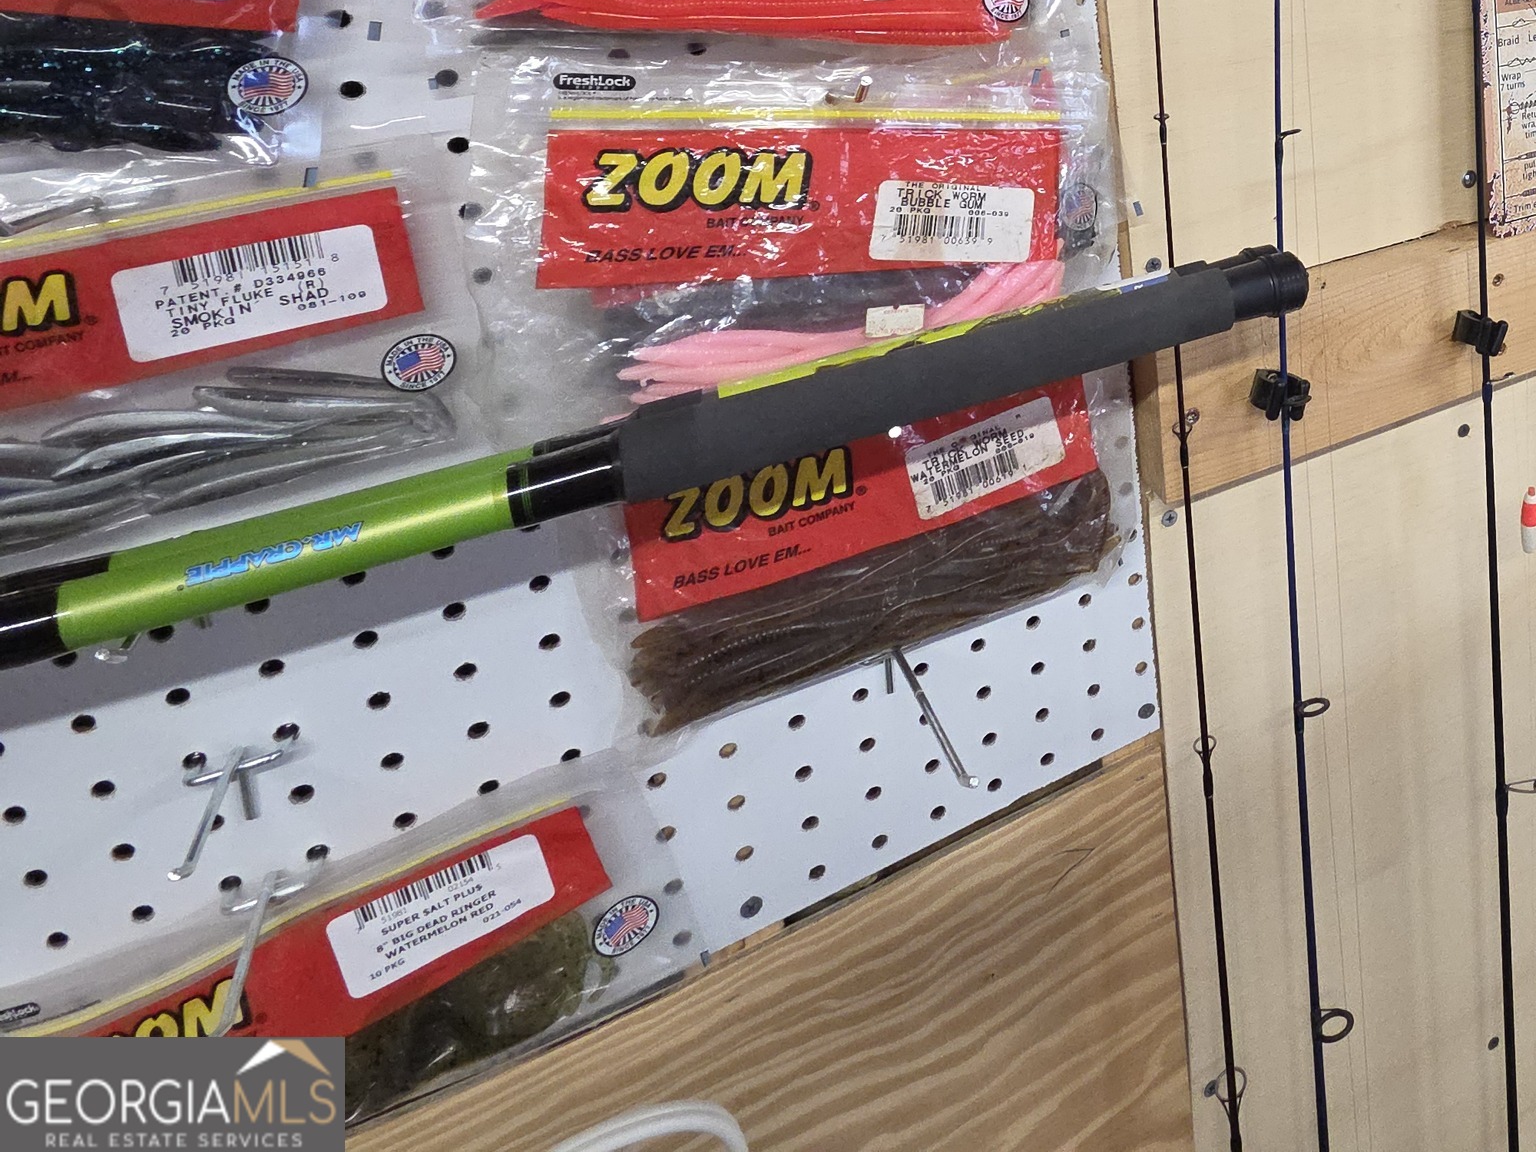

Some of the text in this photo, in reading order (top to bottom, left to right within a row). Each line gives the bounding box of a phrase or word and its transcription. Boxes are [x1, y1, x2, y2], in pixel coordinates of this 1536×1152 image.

[1498, 36, 1520, 47] Braid
[558, 74, 632, 88] FreshLock
[1501, 72, 1522, 82] Wrap
[581, 147, 814, 213] ZOOM
[905, 181, 924, 189] THE
[897, 188, 987, 201] TRICK WORM
[901, 198, 983, 210] BUBBLE GUM
[706, 217, 736, 230] BAIT
[583, 246, 702, 264] BASS LOVE
[253, 267, 326, 288] D334966
[168, 288, 274, 318] TINY FLUKE
[279, 287, 329, 306] SHAD
[203, 290, 367, 331] PKG 081-109
[14, 331, 84, 354] COMPANY
[910, 429, 1024, 483] WATERMELON SEED
[922, 448, 965, 470] TRICK
[662, 445, 853, 542] ZOOM
[768, 501, 855, 537] BAIT COMPANY
[673, 553, 770, 590] BASS LOVE
[380, 916, 421, 937] SUPER
[391, 889, 497, 947] BIG DEAD RINGER
[384, 901, 495, 960] WATERMELON RED
[384, 898, 523, 974] PKG 021-054
